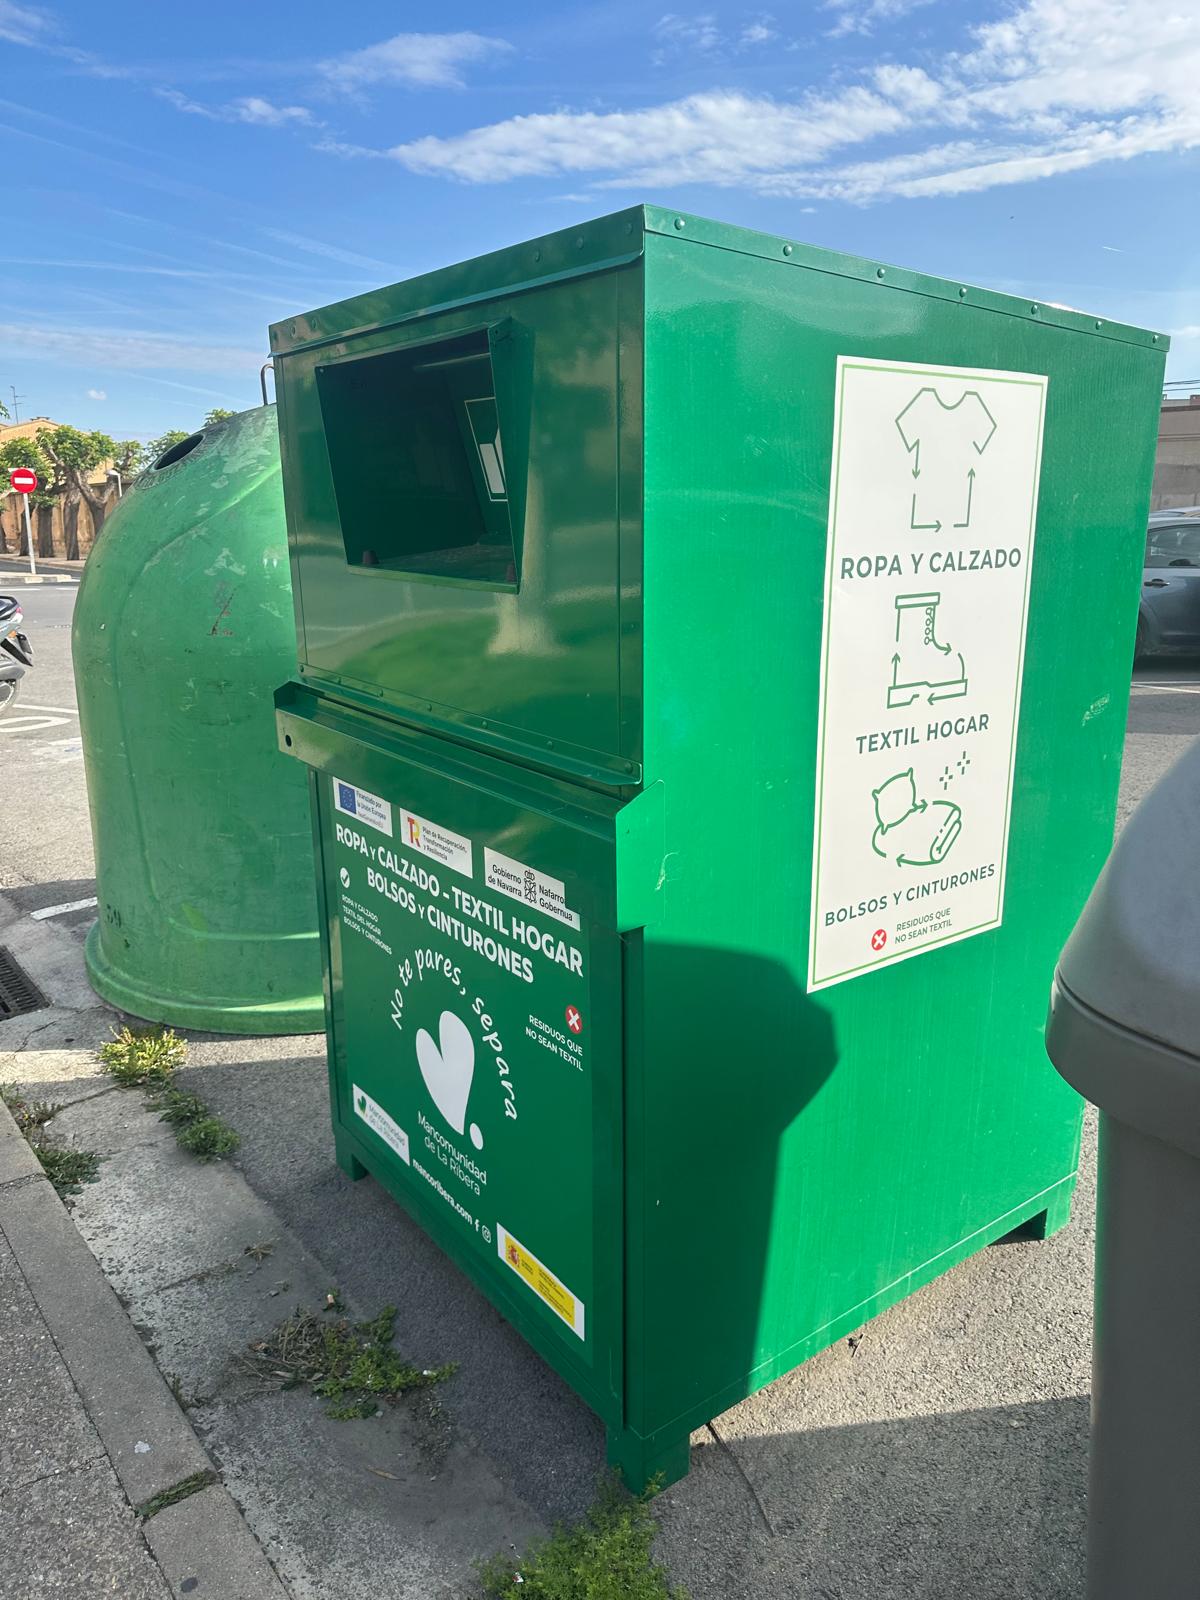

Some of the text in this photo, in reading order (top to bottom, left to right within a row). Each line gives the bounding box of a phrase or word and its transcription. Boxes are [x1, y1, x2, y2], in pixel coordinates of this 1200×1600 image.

[841, 548, 1022, 579] ROPA Y CALZADO
[856, 713, 990, 754] TEXTIL HOGAR
[488, 875, 522, 897] de Navarra
[492, 864, 522, 885] Gobierno
[825, 863, 996, 927] BOLSOS Y CINTURONES
[336, 823, 369, 857] ROPA
[370, 846, 376, 861] Y
[378, 846, 440, 897] CALZADO
[452, 886, 509, 936] TEXTIL
[512, 916, 584, 978] HOGAR
[358, 904, 378, 922] CALZADO
[539, 897, 573, 922] Gobernua
[896, 907, 951, 932] RESIDUOS QUE
[367, 867, 534, 983] BOLSOS Y CINTURONES
[894, 918, 953, 944] NO SEAN TEXTIL
[399, 958, 412, 986] te
[415, 949, 466, 995] pares,
[472, 997, 518, 1120] separa
[525, 1026, 584, 1072] NO SEAN TEXTIL
[529, 1014, 583, 1057] RESIDUOS QUE
[418, 1110, 487, 1185] Mancomunidad
[424, 1136, 480, 1196] de La Ribera
[412, 1158, 472, 1225] mancoribera.com
